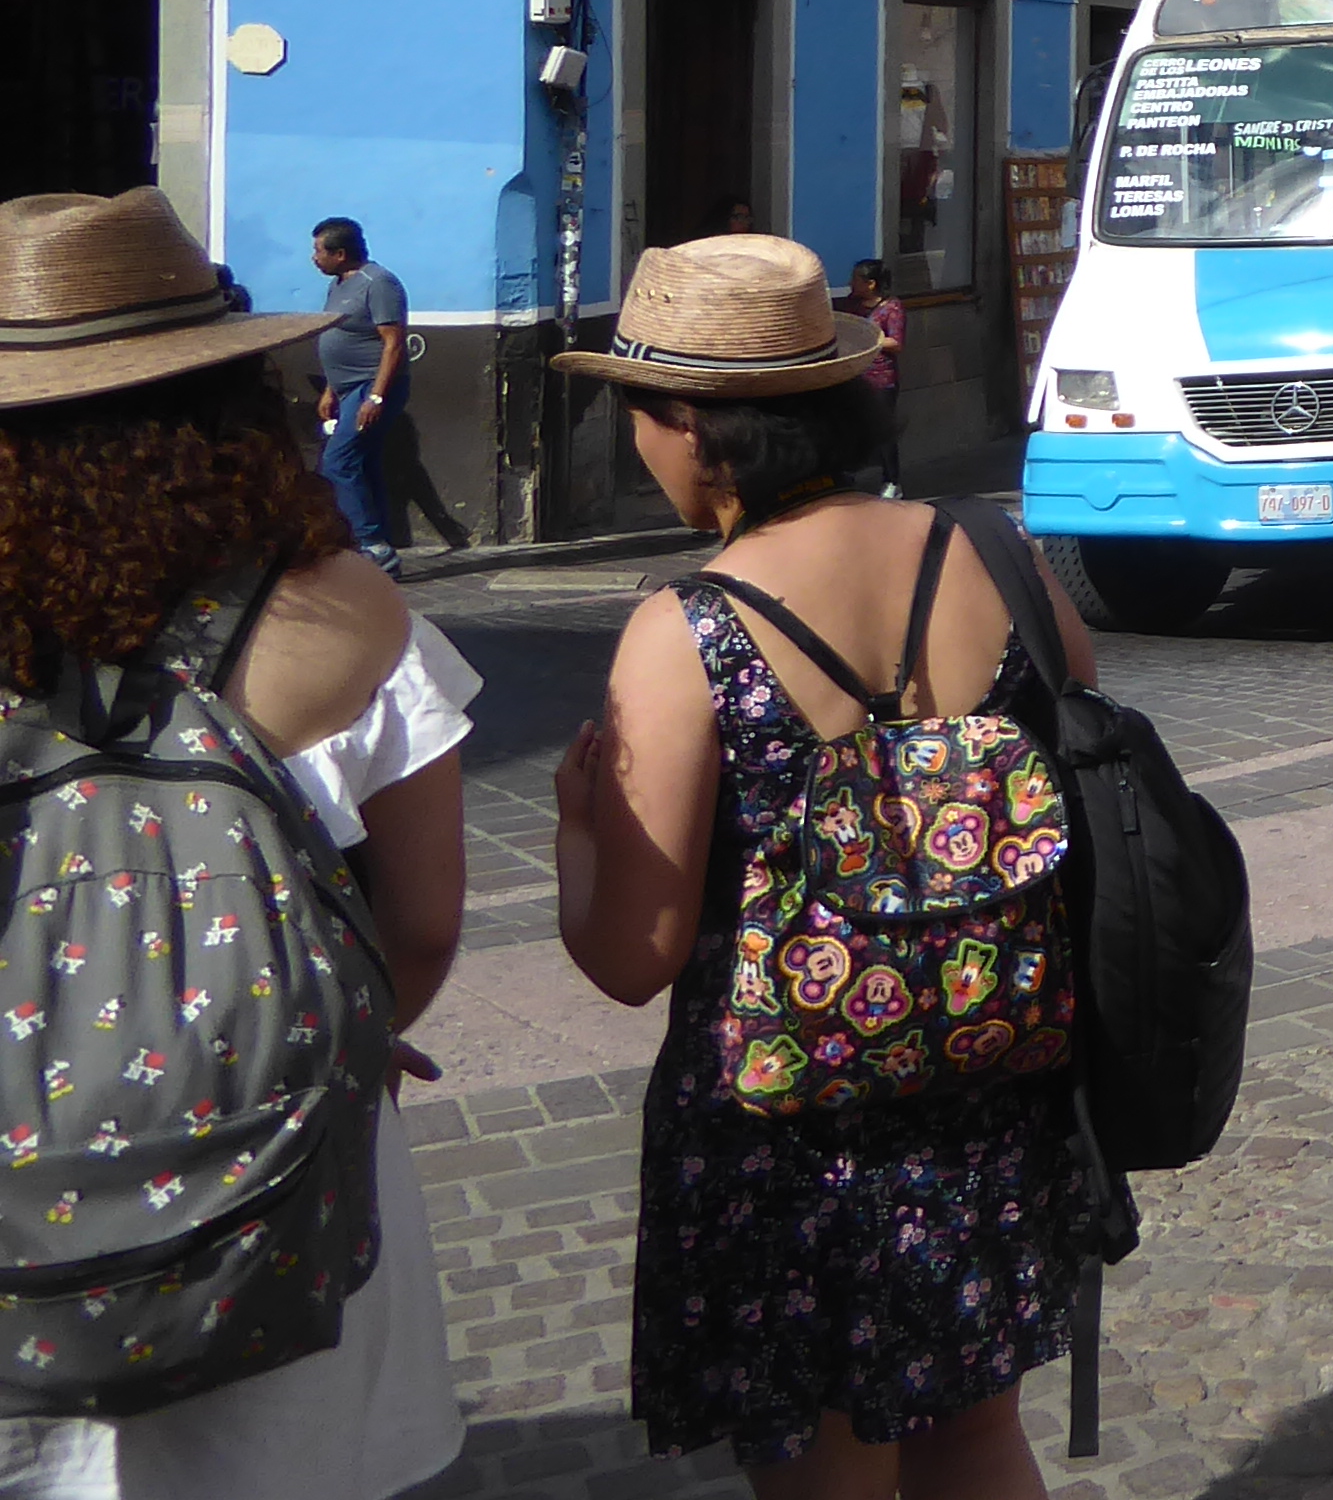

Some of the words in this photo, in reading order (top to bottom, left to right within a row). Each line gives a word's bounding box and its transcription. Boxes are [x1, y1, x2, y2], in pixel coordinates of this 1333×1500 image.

[1143, 57, 1186, 68] CERRO
[1186, 57, 1262, 72] LEONES
[1139, 67, 1157, 76] DE
[1159, 66, 1185, 76] LOS
[1135, 76, 1199, 90] PASTITA
[1132, 85, 1249, 101] EMBAJADORAS
[1130, 100, 1193, 114] CENTRO
[1126, 114, 1201, 130] PANTEON
[1233, 120, 1281, 136] SANGRE
[1119, 145, 1133, 158] P.
[1136, 144, 1158, 157] DE
[1160, 142, 1217, 157] ROCHA
[1115, 174, 1174, 189] MARFIL
[1113, 190, 1184, 204] TERESAS
[1110, 203, 1165, 219] LOMAS
